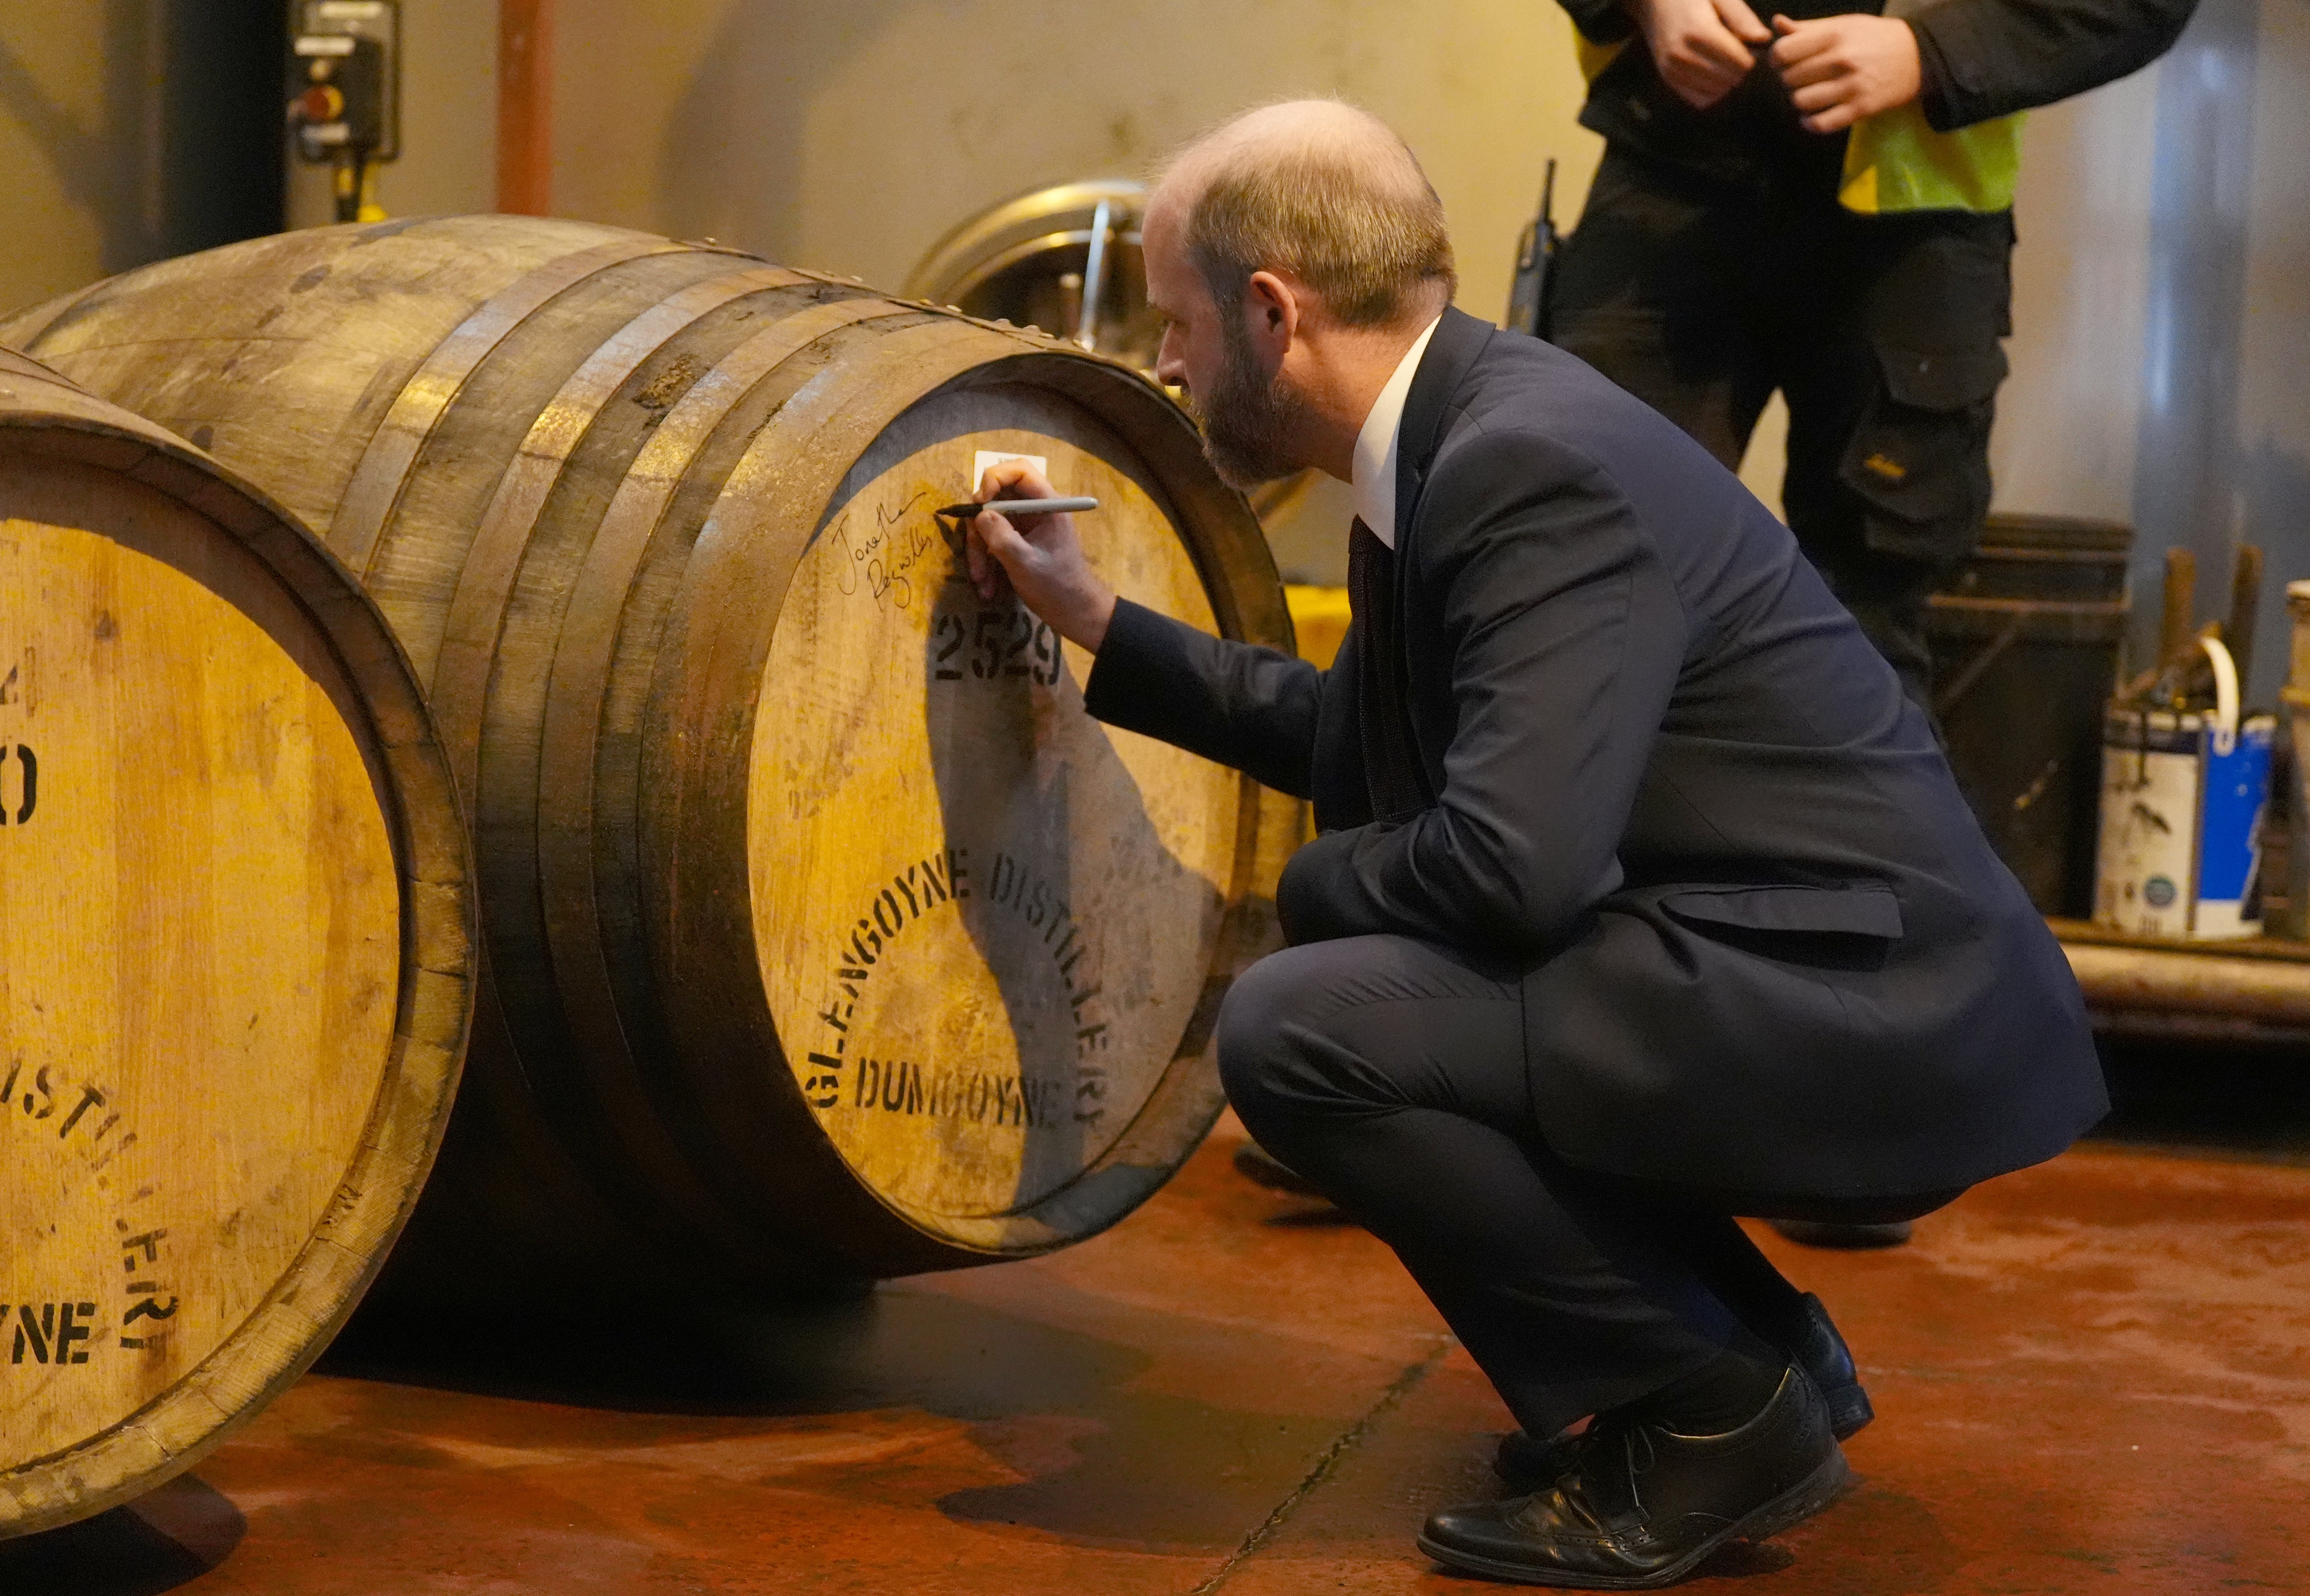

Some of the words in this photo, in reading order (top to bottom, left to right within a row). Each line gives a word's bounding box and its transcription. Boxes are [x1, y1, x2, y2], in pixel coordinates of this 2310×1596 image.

[935, 612, 1061, 686] 2529
[804, 847, 970, 1109] GLENGOYNE
[990, 851, 1108, 1128] DISTILLERY
